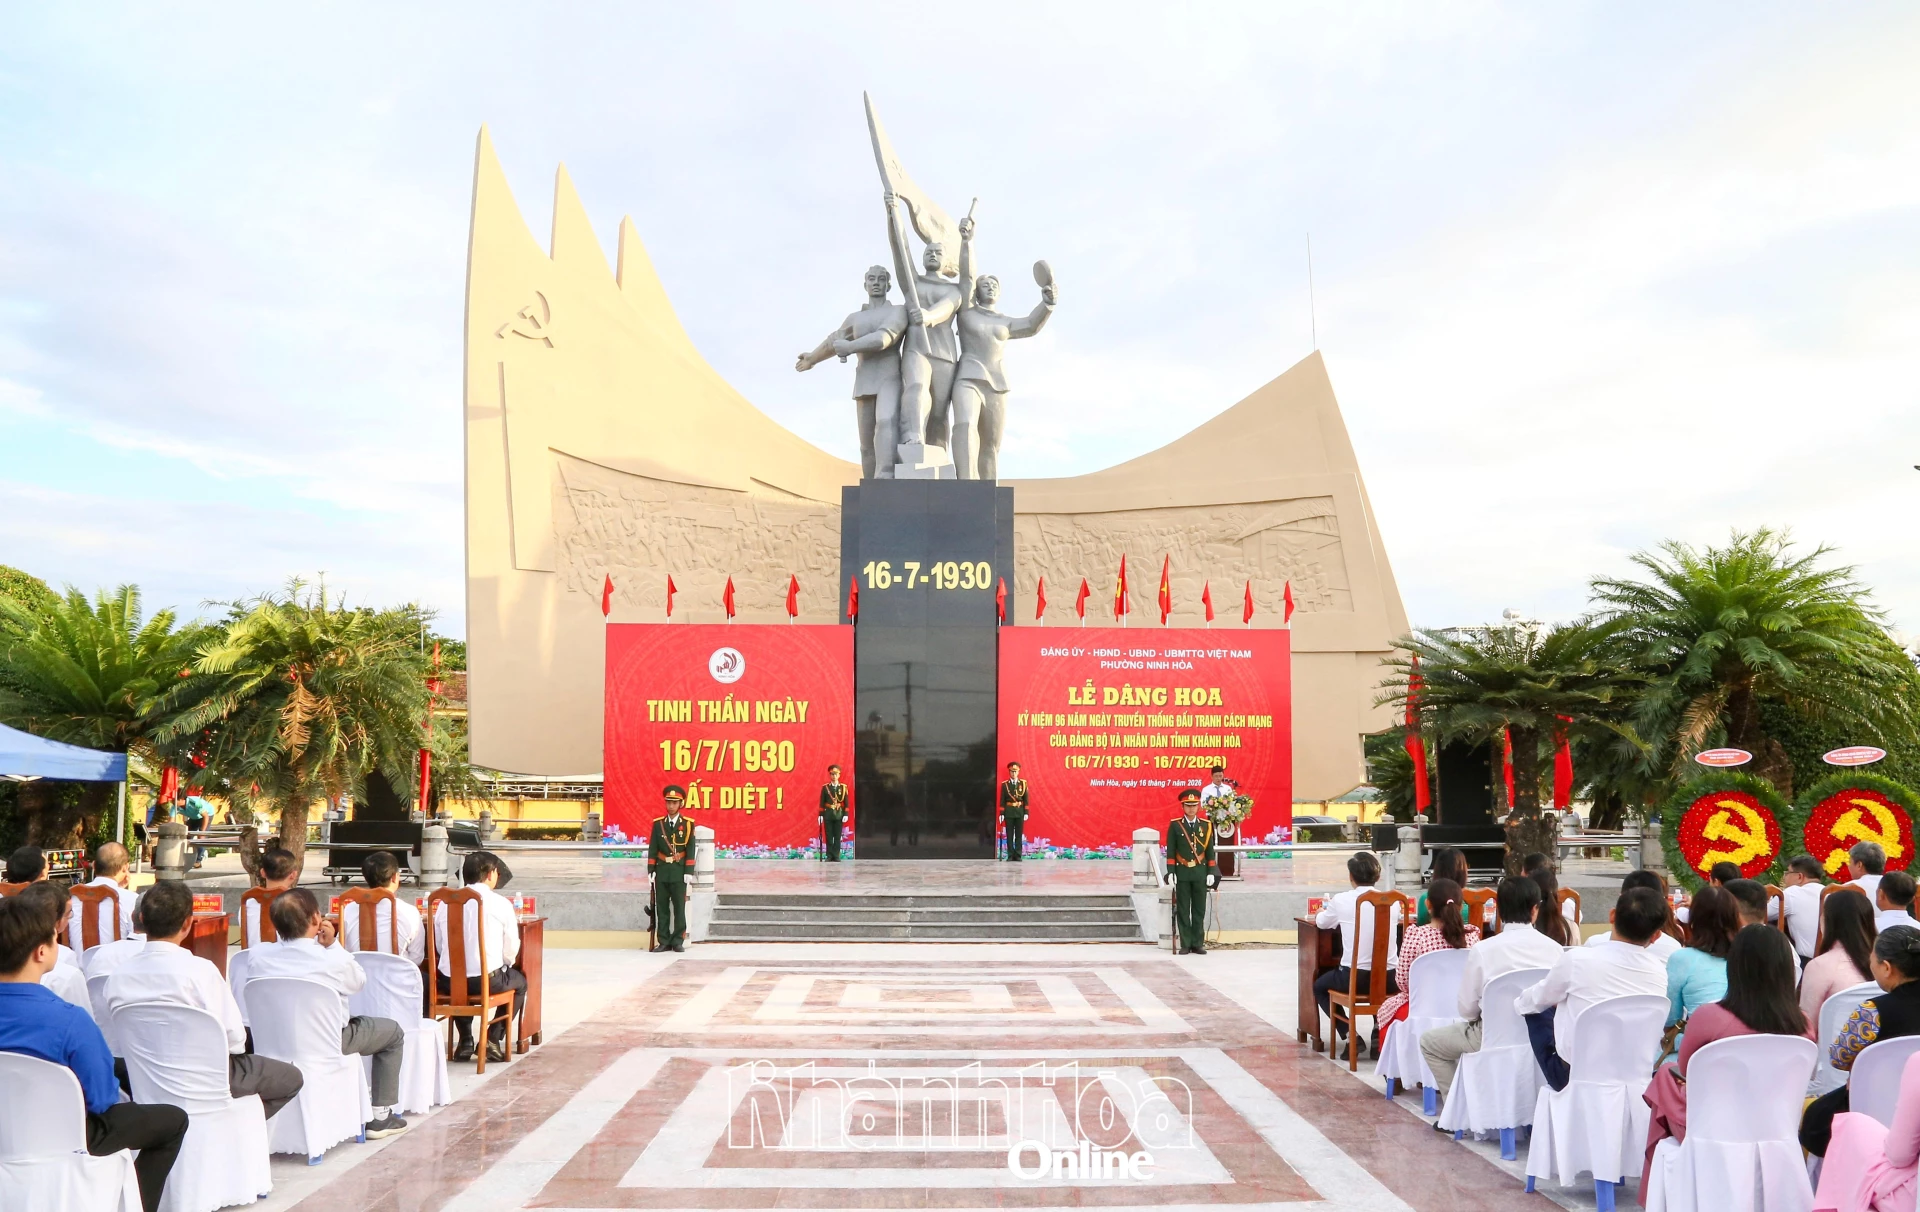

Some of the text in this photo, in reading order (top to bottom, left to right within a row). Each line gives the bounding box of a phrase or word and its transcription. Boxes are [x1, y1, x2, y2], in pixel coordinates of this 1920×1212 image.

[863, 561, 992, 590] 16-7-1930
[1041, 647, 1069, 657] ĐẢNG
[1071, 647, 1085, 657] ỦY
[1093, 649, 1121, 657] HĐND
[1129, 649, 1156, 657] UBND
[1164, 650, 1205, 658] UBMTTQ
[1207, 649, 1228, 659] VIỆT
[1230, 650, 1252, 658] NAM
[1100, 659, 1193, 670] PHƯỜNG NINH HÒA
[1068, 679, 1223, 706] LỄ DÂNG HOA
[647, 693, 809, 723] TINH THẦN NGÀY
[1018, 710, 1030, 727] KỶ
[1031, 711, 1053, 729] NIỆM
[1055, 714, 1066, 727] 96
[1068, 712, 1087, 727] NĂM
[1089, 712, 1112, 727] NGÀY
[1147, 711, 1174, 727] THỐNG
[1176, 711, 1193, 727] ĐẤU
[1195, 714, 1222, 727] TRANH
[1224, 712, 1245, 727] CÁCH
[1247, 715, 1272, 730] MẠNG
[1050, 730, 1241, 750] CỦA ĐẢNG BỘ VÀ NHÂN DÂN TỈNH KHÁNH HÒA
[659, 739, 795, 772] 16/7/1930
[1065, 755, 1140, 769] (16/7/1930
[1154, 755, 1227, 769] 16/7/2026)
[1090, 779, 1105, 787] Ninh
[1122, 779, 1138, 788] ngày
[1139, 779, 1146, 787] 16
[1148, 779, 1166, 788] tháng
[1172, 779, 1186, 787] năm
[1187, 779, 1203, 787] 2026
[681, 779, 713, 810] ẤT
[720, 782, 769, 814] DIỆT
